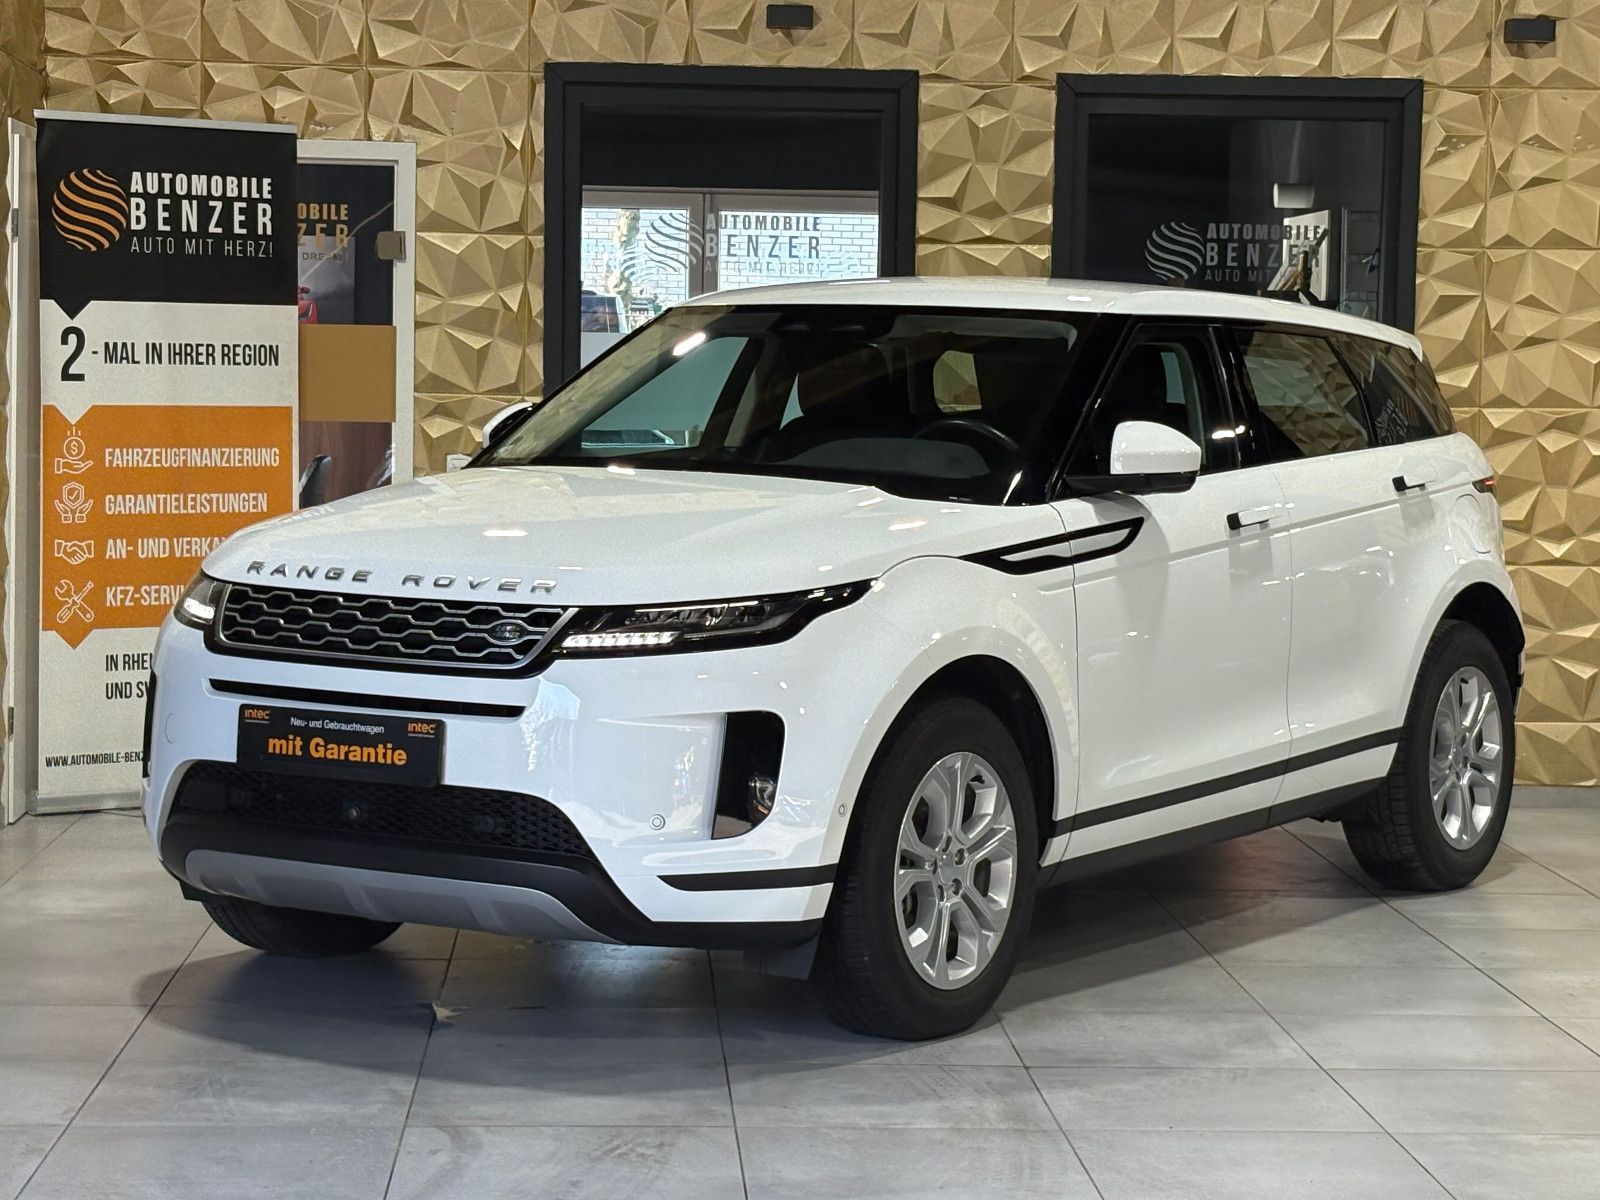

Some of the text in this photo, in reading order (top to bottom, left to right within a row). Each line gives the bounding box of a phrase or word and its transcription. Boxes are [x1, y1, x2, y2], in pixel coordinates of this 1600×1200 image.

[130, 171, 272, 199] AUTOMOBILE
[130, 198, 272, 236] BENZER
[705, 213, 820, 232] AUTOMOBILE
[1206, 223, 1321, 241] AUTOMOBILE
[131, 237, 273, 257] AUTO MIT HERZ!
[706, 233, 820, 260] BENZER
[1205, 242, 1320, 268] BENZER
[1205, 269, 1240, 282] AUTO
[146, 343, 162, 365] IN
[168, 343, 216, 366] IHRER
[221, 344, 279, 367] REGION
[104, 447, 280, 468] FAHRZEUGFINANZIERUNG
[105, 493, 268, 515] GARANTIELEISTUNGEN
[105, 536, 226, 559] AN- UND VERKA
[247, 560, 558, 594] RANGE ROVER
[105, 654, 119, 672] IN
[105, 681, 132, 700] UND
[244, 709, 271, 720] intec
[290, 717, 385, 735] Neu- und Gebrauchtwagen
[408, 722, 437, 734] intec
[268, 735, 408, 766] mit Garantie
